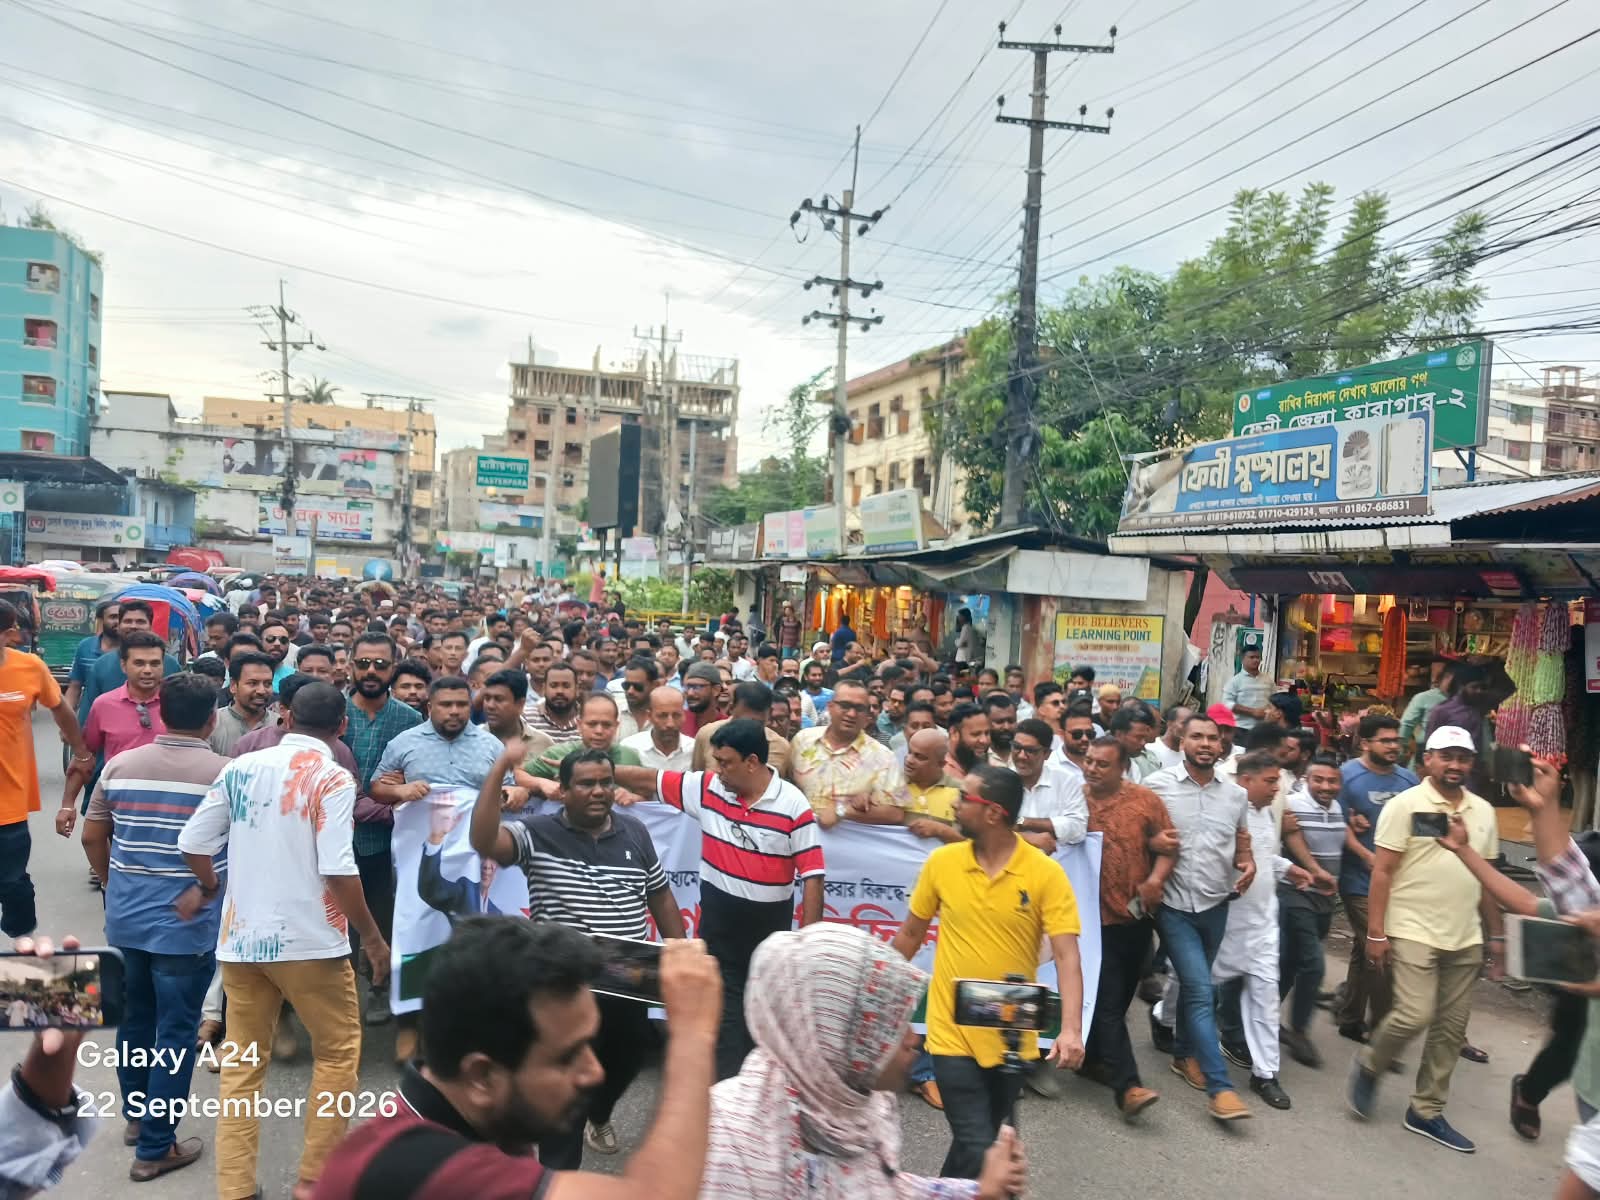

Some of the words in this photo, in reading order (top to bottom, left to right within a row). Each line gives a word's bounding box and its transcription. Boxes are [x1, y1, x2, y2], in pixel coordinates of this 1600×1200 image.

[1278, 394, 1302, 413] রাখিব
[1304, 390, 1337, 408] নিরাপদ
[1339, 384, 1368, 402] দেখাব
[1370, 376, 1408, 396] আলোর
[1342, 388, 1467, 421] কারাগার-২
[478, 476, 527, 487] MASTERPARA
[1344, 500, 1410, 514] 01867-686831
[1065, 615, 1088, 627] THE
[1091, 616, 1149, 629] BELIEVERS
[1066, 629, 1121, 641] LEARNING
[1123, 630, 1152, 642] POINT
